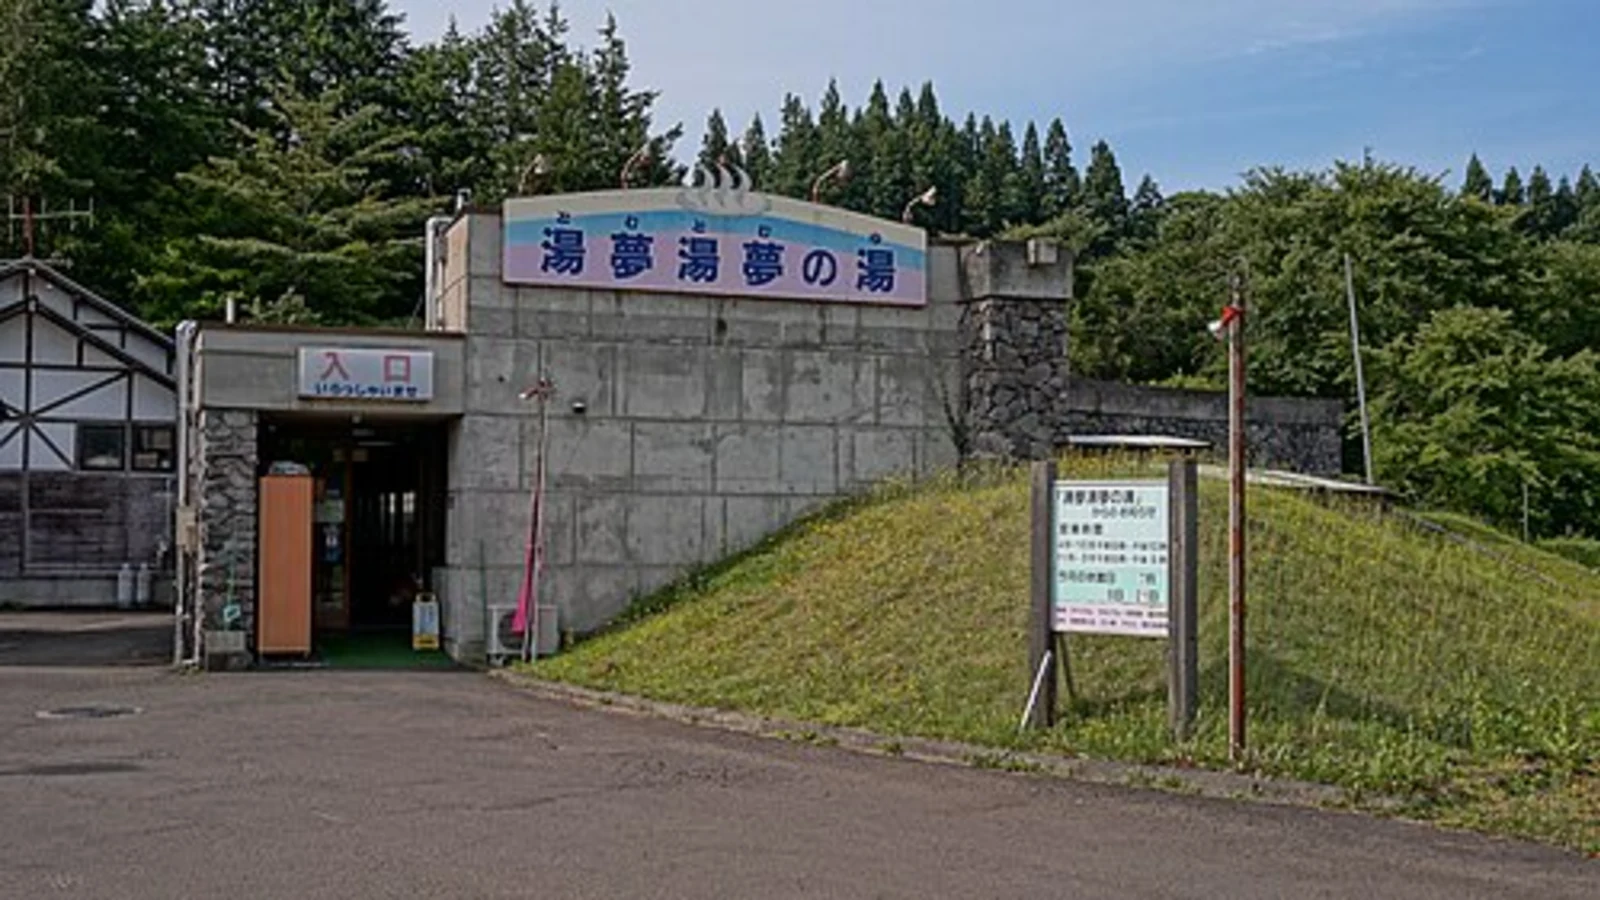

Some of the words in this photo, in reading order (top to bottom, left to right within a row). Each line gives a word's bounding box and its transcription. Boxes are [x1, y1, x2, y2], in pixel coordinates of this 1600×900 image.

[540, 228, 896, 293] 湯夢湯夢の湯
[319, 351, 412, 382] 入口
